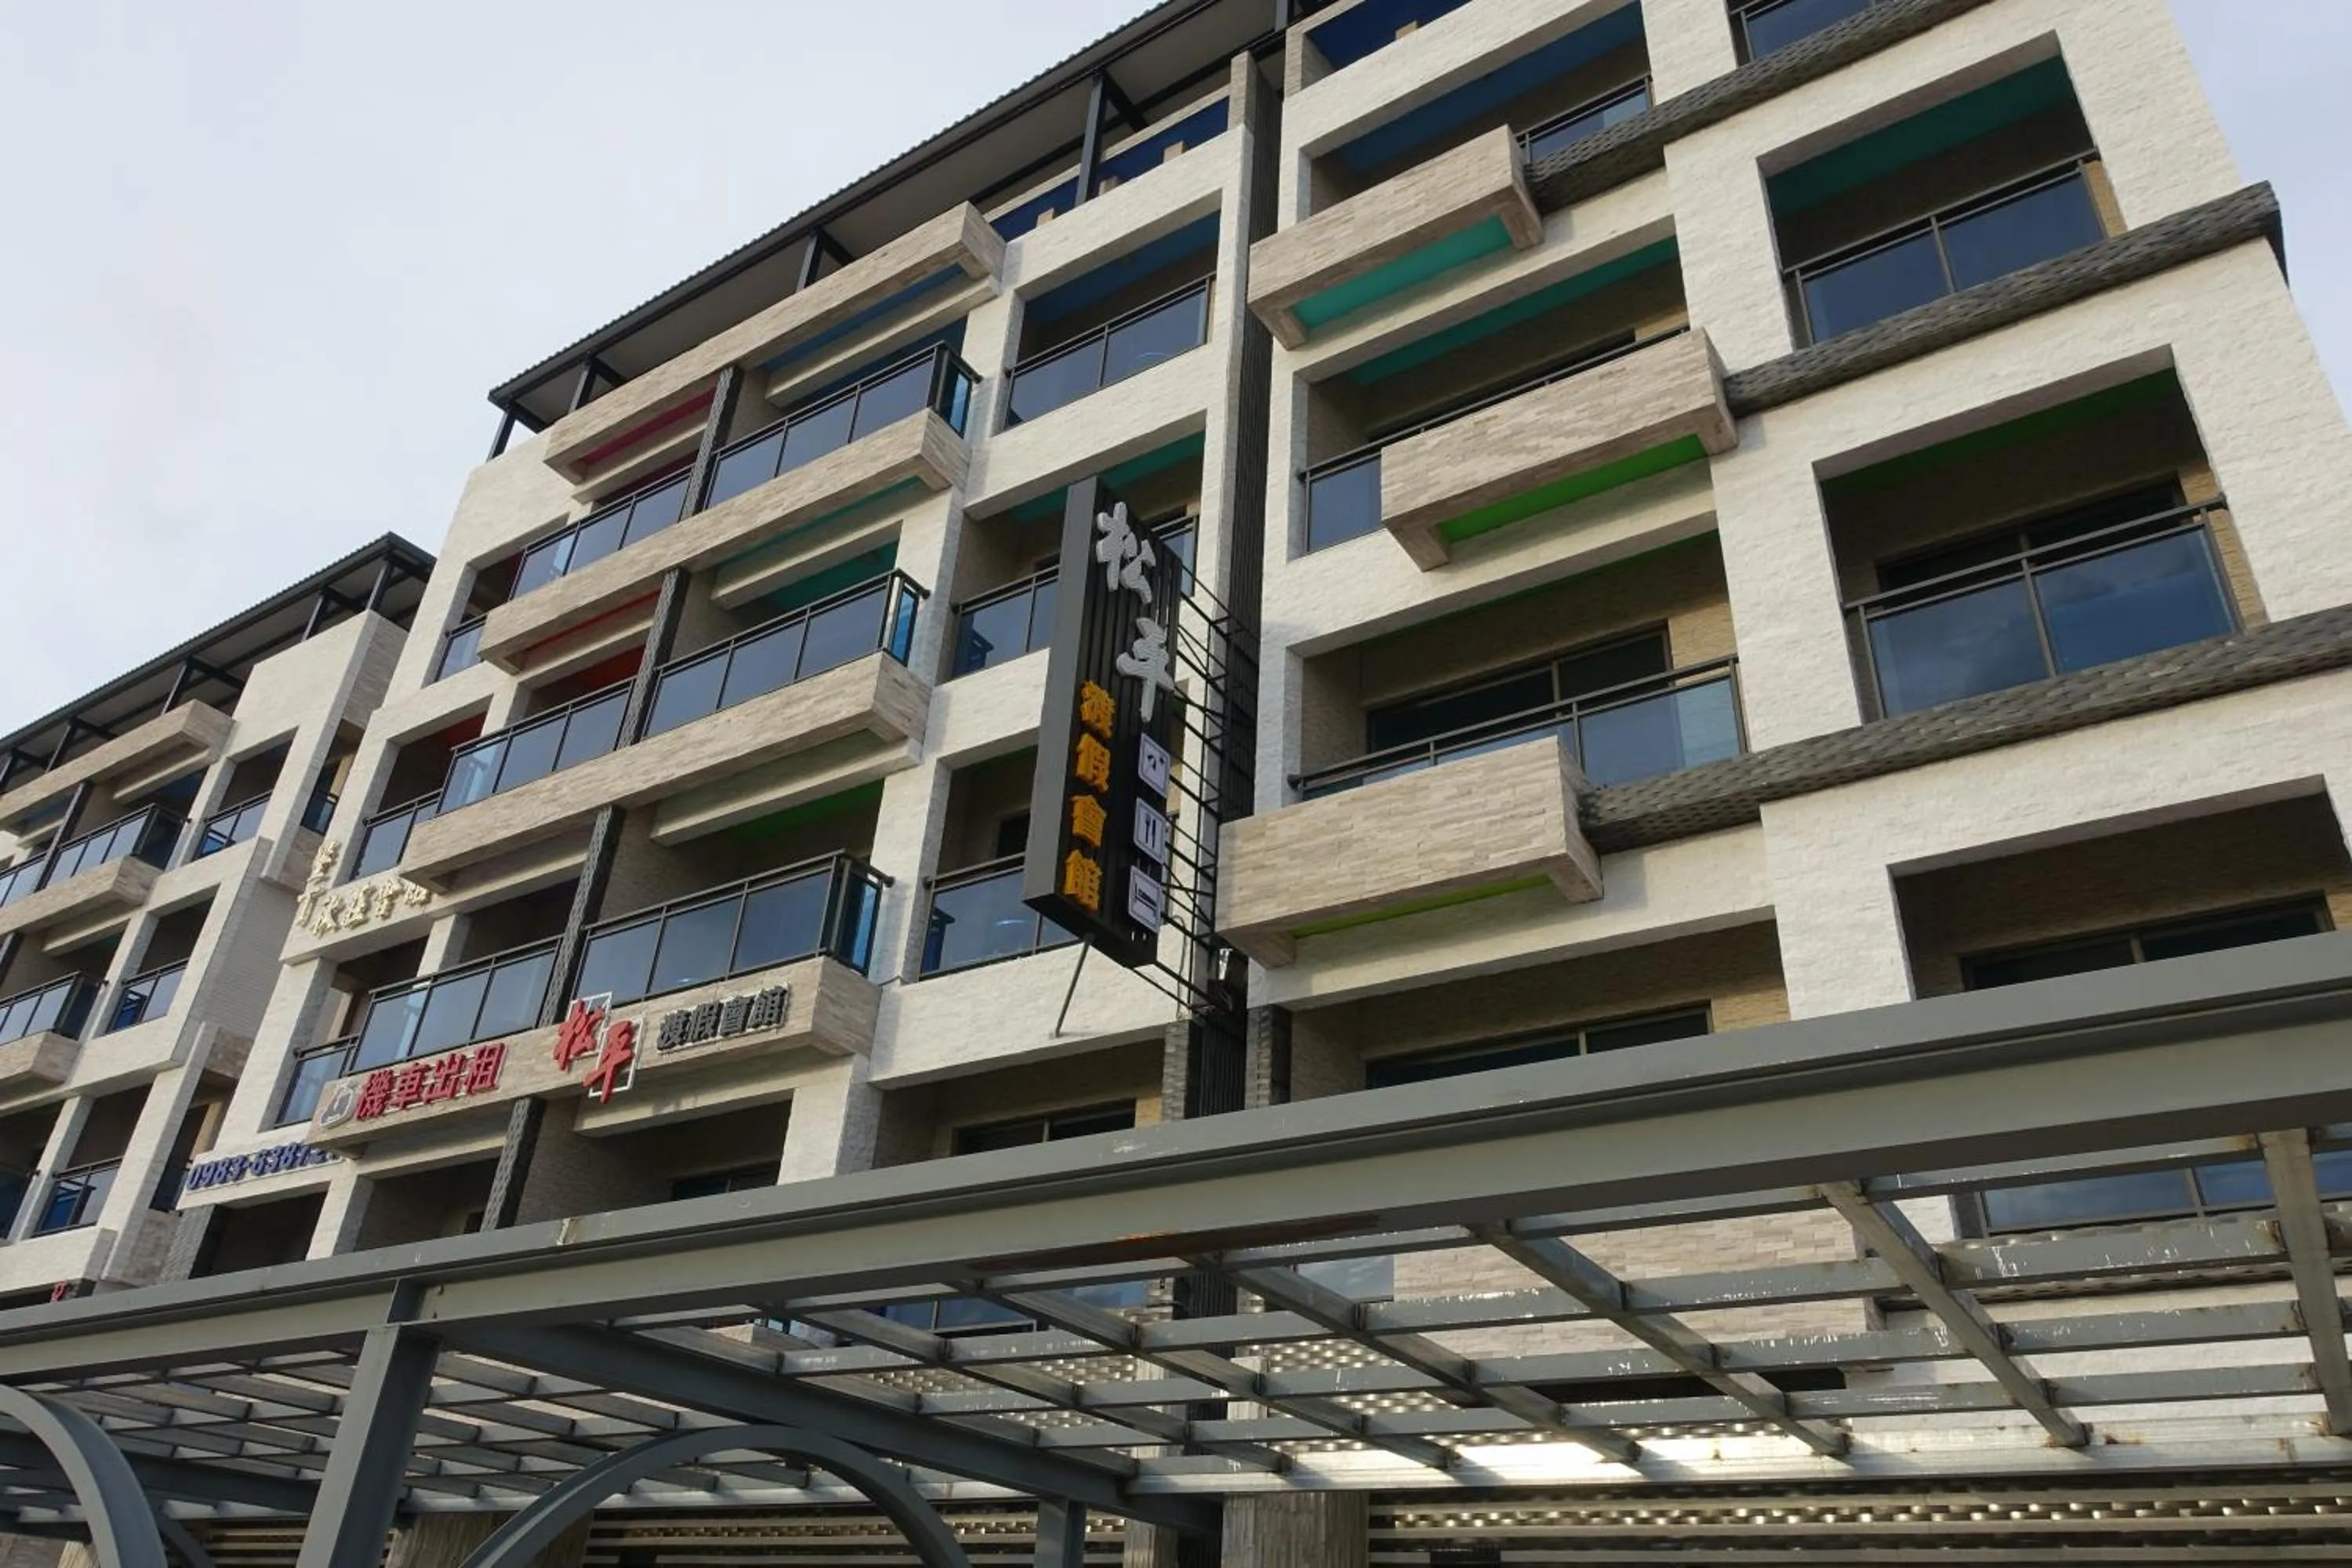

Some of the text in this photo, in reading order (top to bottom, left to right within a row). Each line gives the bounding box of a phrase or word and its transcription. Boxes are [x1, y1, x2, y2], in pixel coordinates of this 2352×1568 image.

[656, 984, 789, 1051] 渡假會館
[354, 1042, 506, 1122] 機車出租
